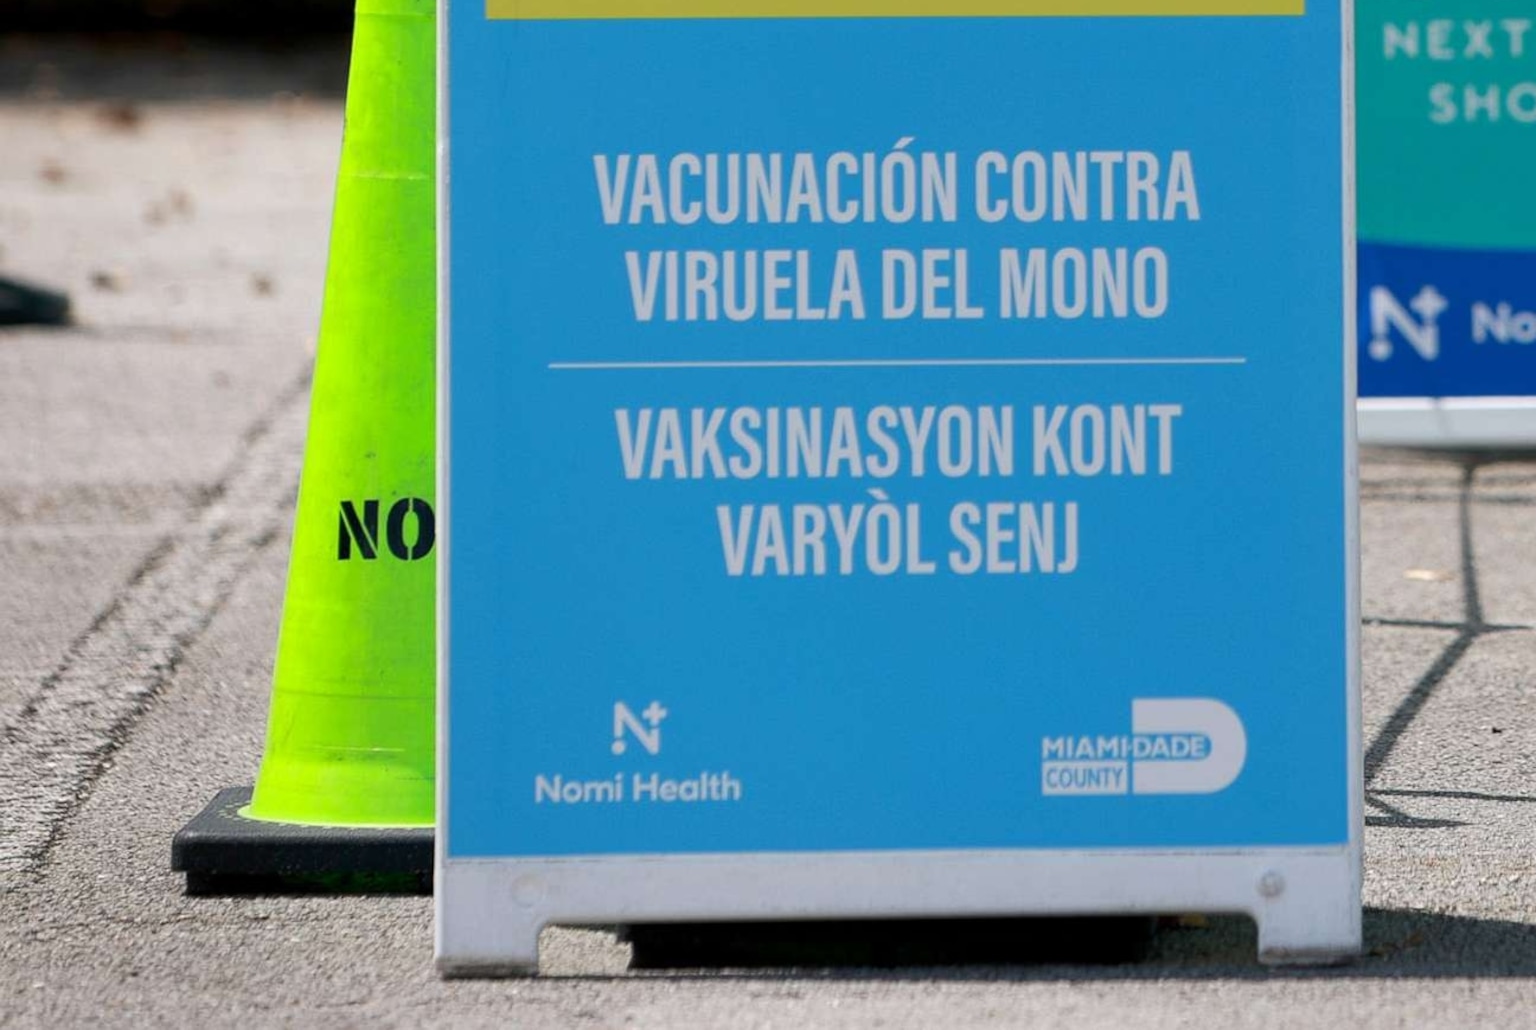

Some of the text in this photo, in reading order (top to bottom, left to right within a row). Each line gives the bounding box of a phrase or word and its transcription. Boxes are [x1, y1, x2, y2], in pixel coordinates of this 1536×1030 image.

[1383, 18, 1532, 60] NEXT
[592, 136, 1201, 226] VACUNACIÓN CONTRA
[624, 245, 1169, 322] VIRUELA DEL MONO
[614, 403, 1183, 480] VAKSINASYON KONT
[338, 497, 435, 561] NO
[715, 487, 1079, 577] VARYÒL SENJ
[534, 770, 742, 804] Nomi Health
[1045, 766, 1123, 789] COUNTY
